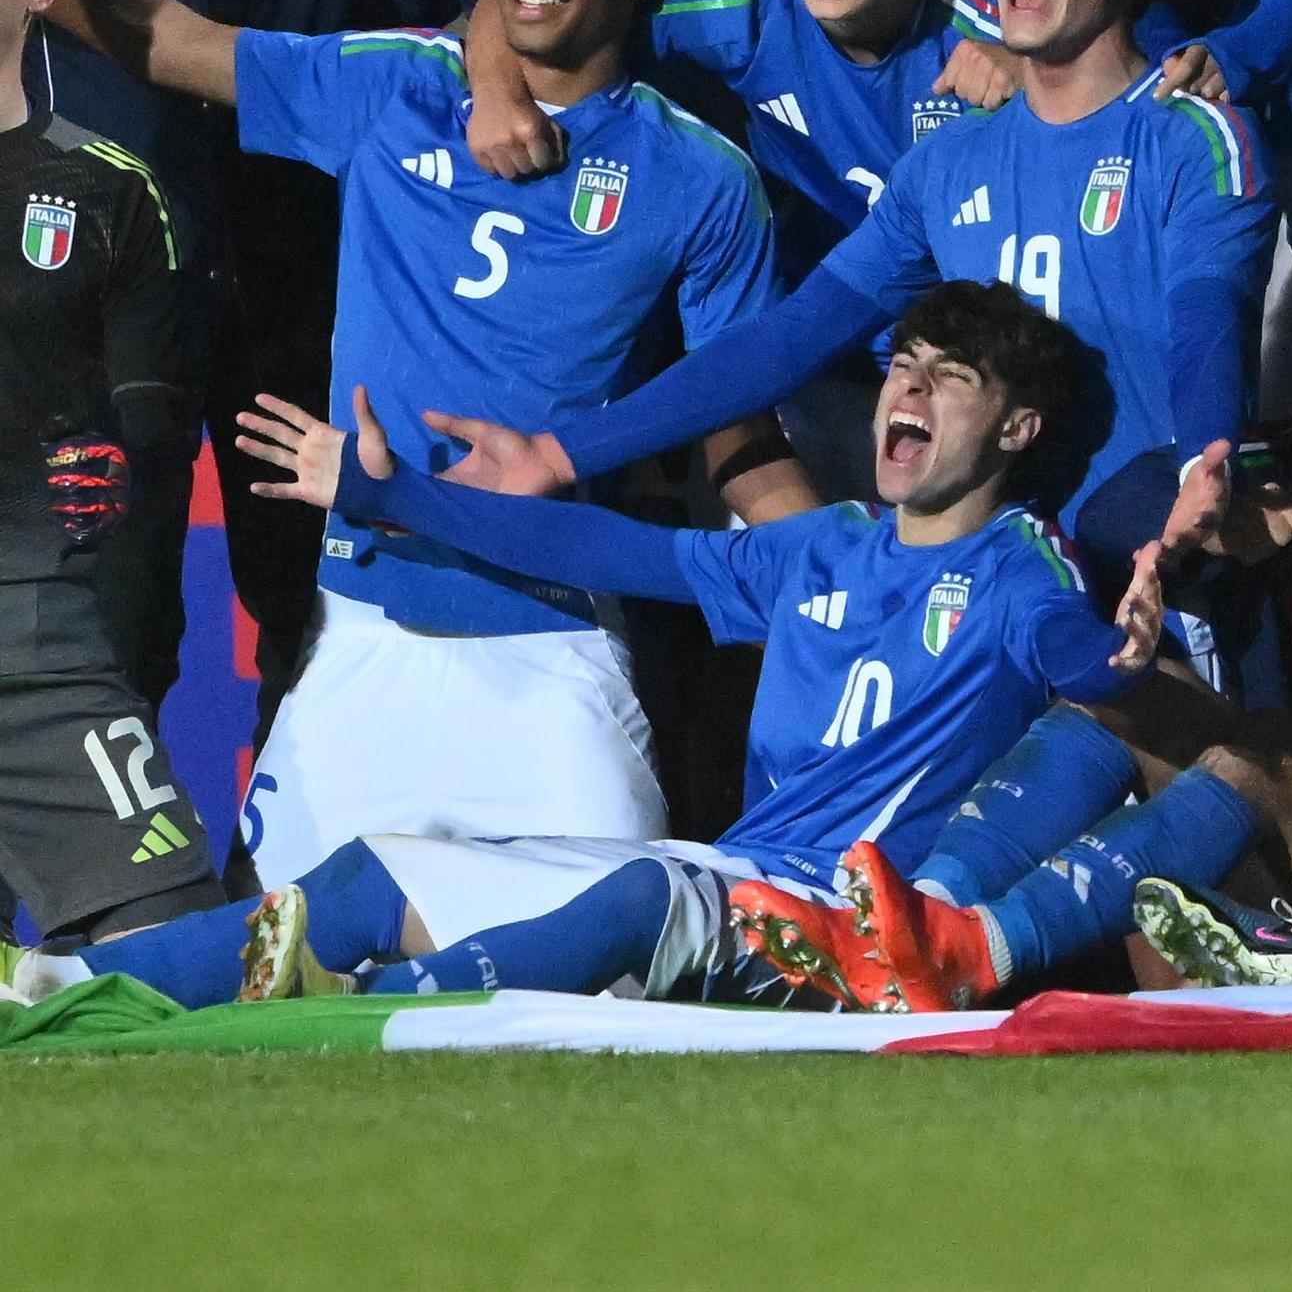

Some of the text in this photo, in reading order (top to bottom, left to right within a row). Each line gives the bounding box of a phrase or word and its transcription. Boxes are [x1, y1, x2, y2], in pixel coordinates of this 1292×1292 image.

[29, 208, 70, 226] ITALIA
[581, 173, 621, 192] ITALIA
[1092, 173, 1124, 186] ITALIA
[453, 211, 525, 299] 5
[999, 234, 1061, 321] 19
[931, 590, 964, 606] ITALIA
[821, 657, 893, 748] 10
[84, 716, 177, 820] 12
[244, 772, 278, 857] 5
